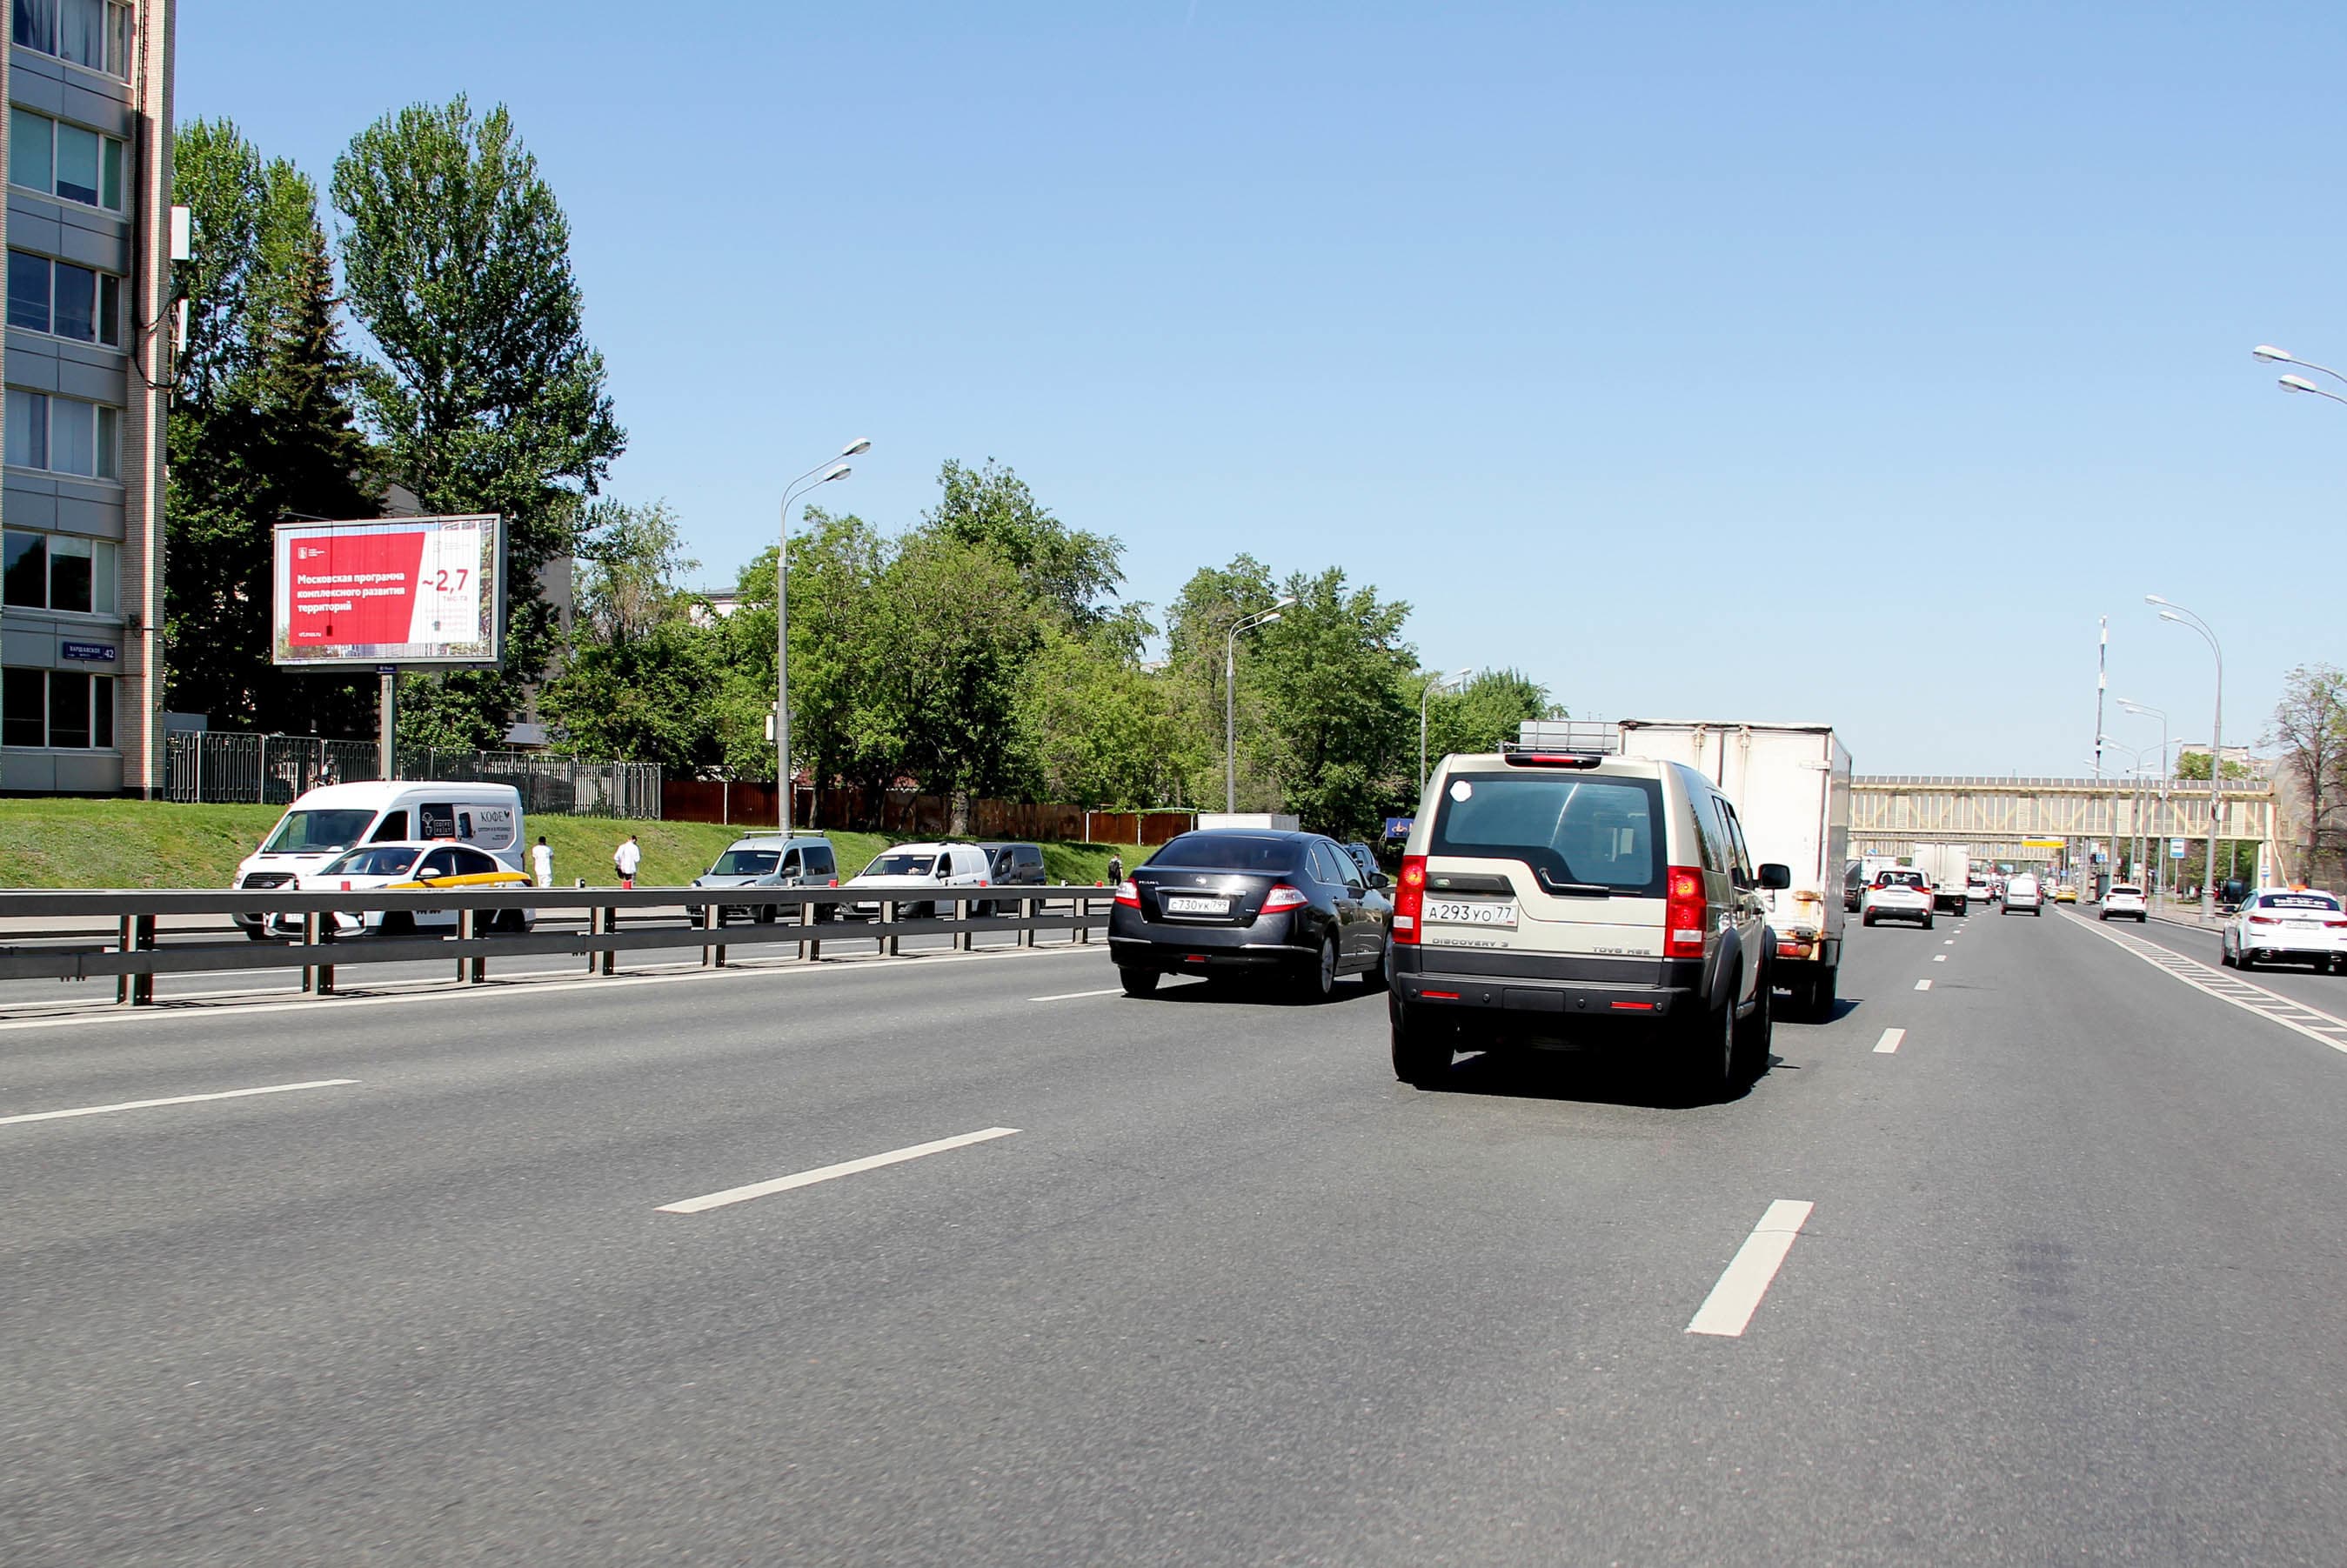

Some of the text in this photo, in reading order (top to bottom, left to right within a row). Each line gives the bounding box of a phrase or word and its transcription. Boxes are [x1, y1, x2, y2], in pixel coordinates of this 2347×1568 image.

[298, 573, 405, 584] Московская программа
[298, 587, 405, 598] комплексного развития
[298, 600, 352, 615] территорий
[70, 645, 114, 658] ВАРШАВСКОЕ 42
[480, 811, 505, 823] КОФЕ
[1497, 906, 1512, 919] 77
[1433, 938, 1495, 947] DISCOVERY
